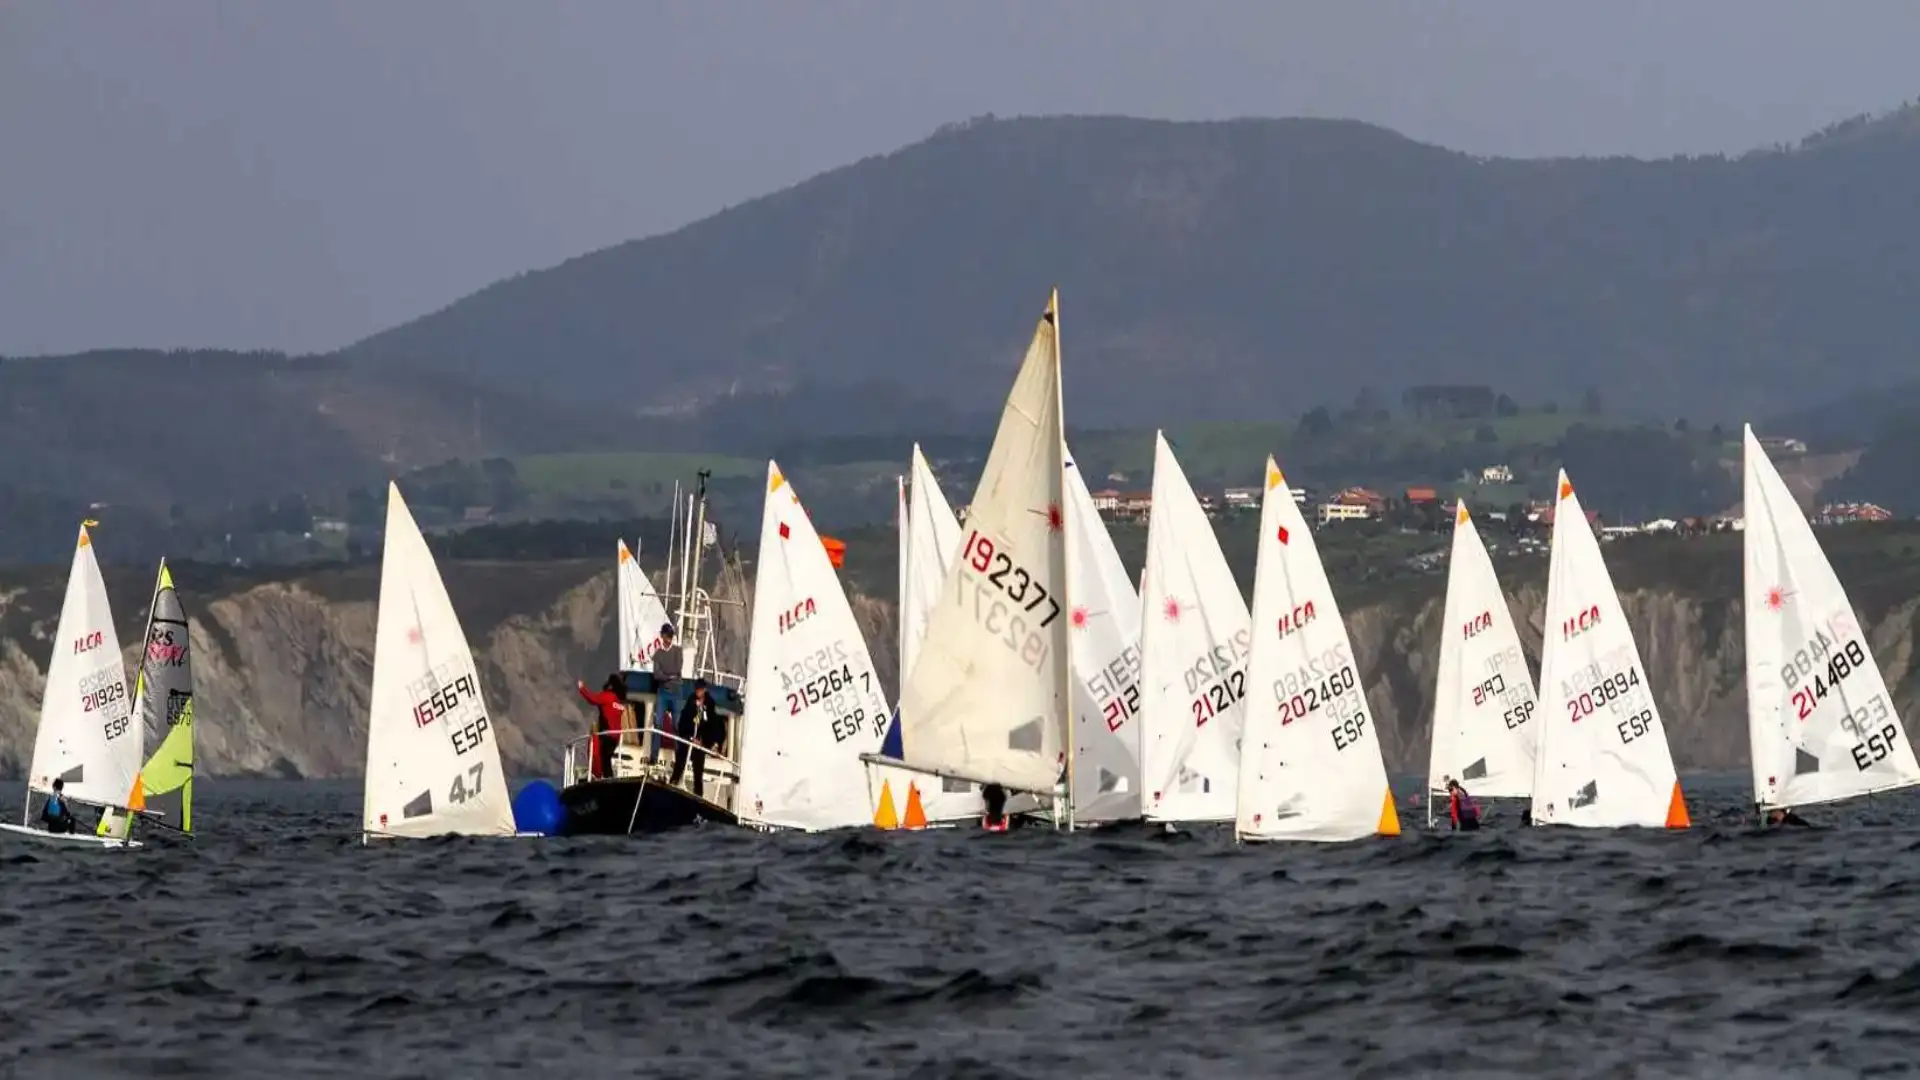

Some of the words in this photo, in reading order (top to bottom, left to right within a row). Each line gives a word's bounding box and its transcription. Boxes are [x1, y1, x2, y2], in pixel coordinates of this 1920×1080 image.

[962, 529, 1060, 628] 192377
[778, 597, 817, 636] ILCA
[1278, 600, 1316, 640] ILCA
[1463, 611, 1492, 641] ILCA
[1562, 605, 1601, 642] ILCA
[74, 631, 103, 655] ILCA
[81, 681, 125, 712] 211929
[785, 663, 854, 717] 215264
[1192, 663, 1248, 728] 21212
[1278, 665, 1355, 726] 202460
[1566, 665, 1641, 723] 203894
[1791, 639, 1866, 721] 214488
[412, 673, 477, 729] 165691
[1502, 699, 1535, 731] ESP
[104, 715, 129, 741] ESP
[451, 716, 489, 756] ESP
[830, 708, 865, 743] ESP
[1330, 711, 1366, 752] ESP
[1616, 708, 1653, 745] ESP
[1850, 723, 1898, 772] ESP
[448, 761, 485, 805] 4.7
